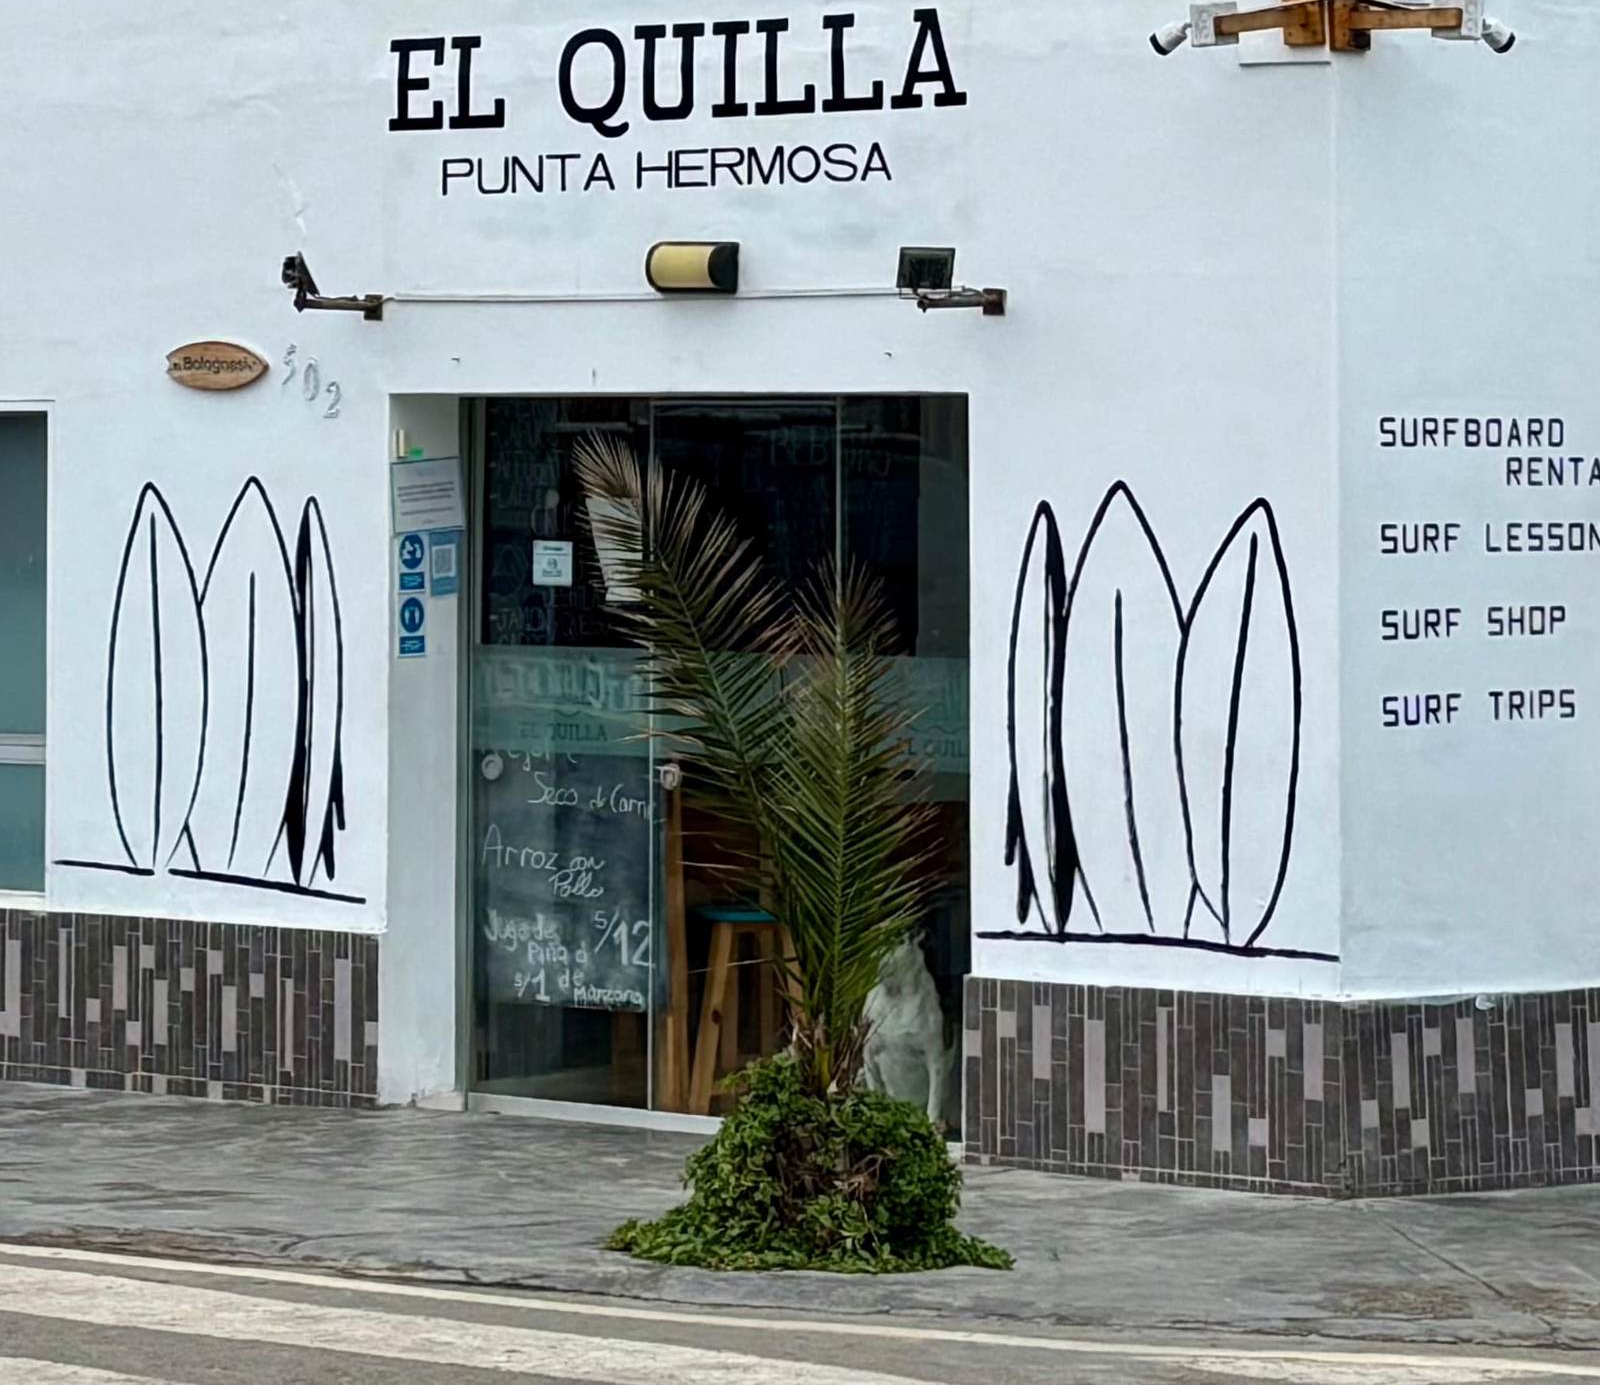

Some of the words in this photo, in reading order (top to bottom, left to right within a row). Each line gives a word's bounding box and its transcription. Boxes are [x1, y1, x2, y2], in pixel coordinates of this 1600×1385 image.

[388, 36, 506, 132] EL
[558, 8, 967, 138] QUILLA
[441, 152, 616, 196] PUNTA
[636, 142, 893, 189] HERMOSA
[282, 343, 342, 419] 502
[1379, 417, 1565, 448] SURFBOARD
[1380, 523, 1461, 554] SURF
[1381, 607, 1462, 641] SURF
[1487, 605, 1566, 636] SHOP
[1382, 693, 1462, 727] SURF
[1488, 689, 1576, 720] TRIPS
[482, 823, 559, 870] Arroz
